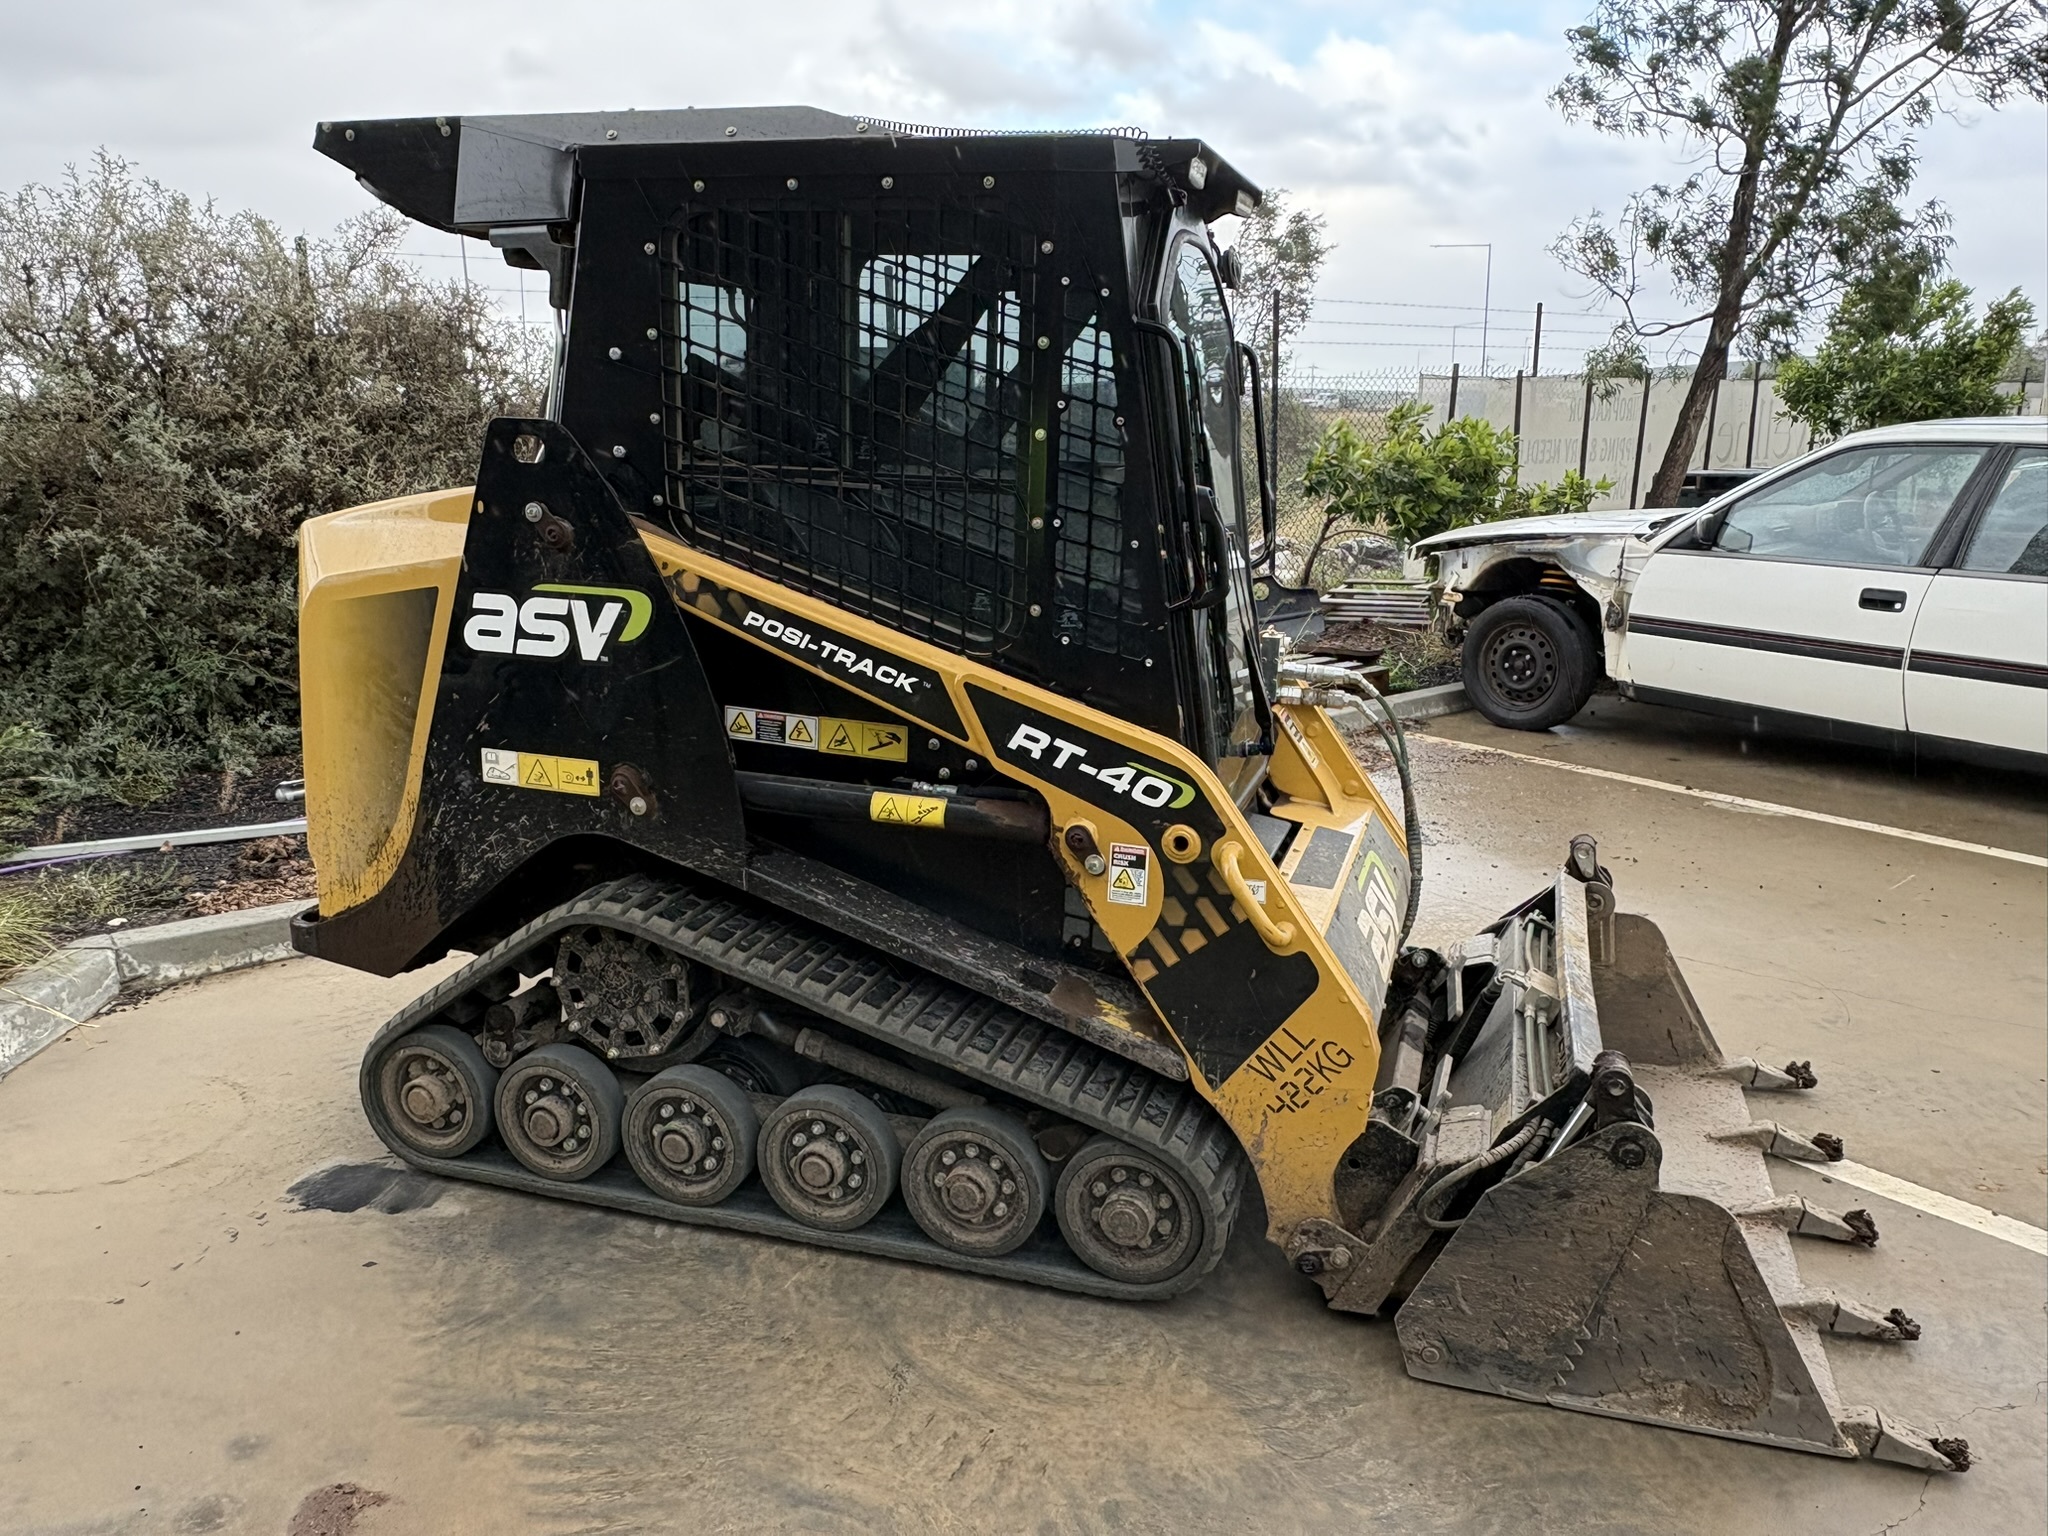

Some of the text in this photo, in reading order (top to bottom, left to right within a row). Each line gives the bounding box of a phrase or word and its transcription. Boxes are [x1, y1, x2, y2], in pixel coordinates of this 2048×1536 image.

[743, 611, 919, 693] POSI-TRACK
[1007, 724, 1173, 808] RT-40
[1246, 1027, 1317, 1083] WLL
[1266, 1041, 1355, 1113] 422KG
